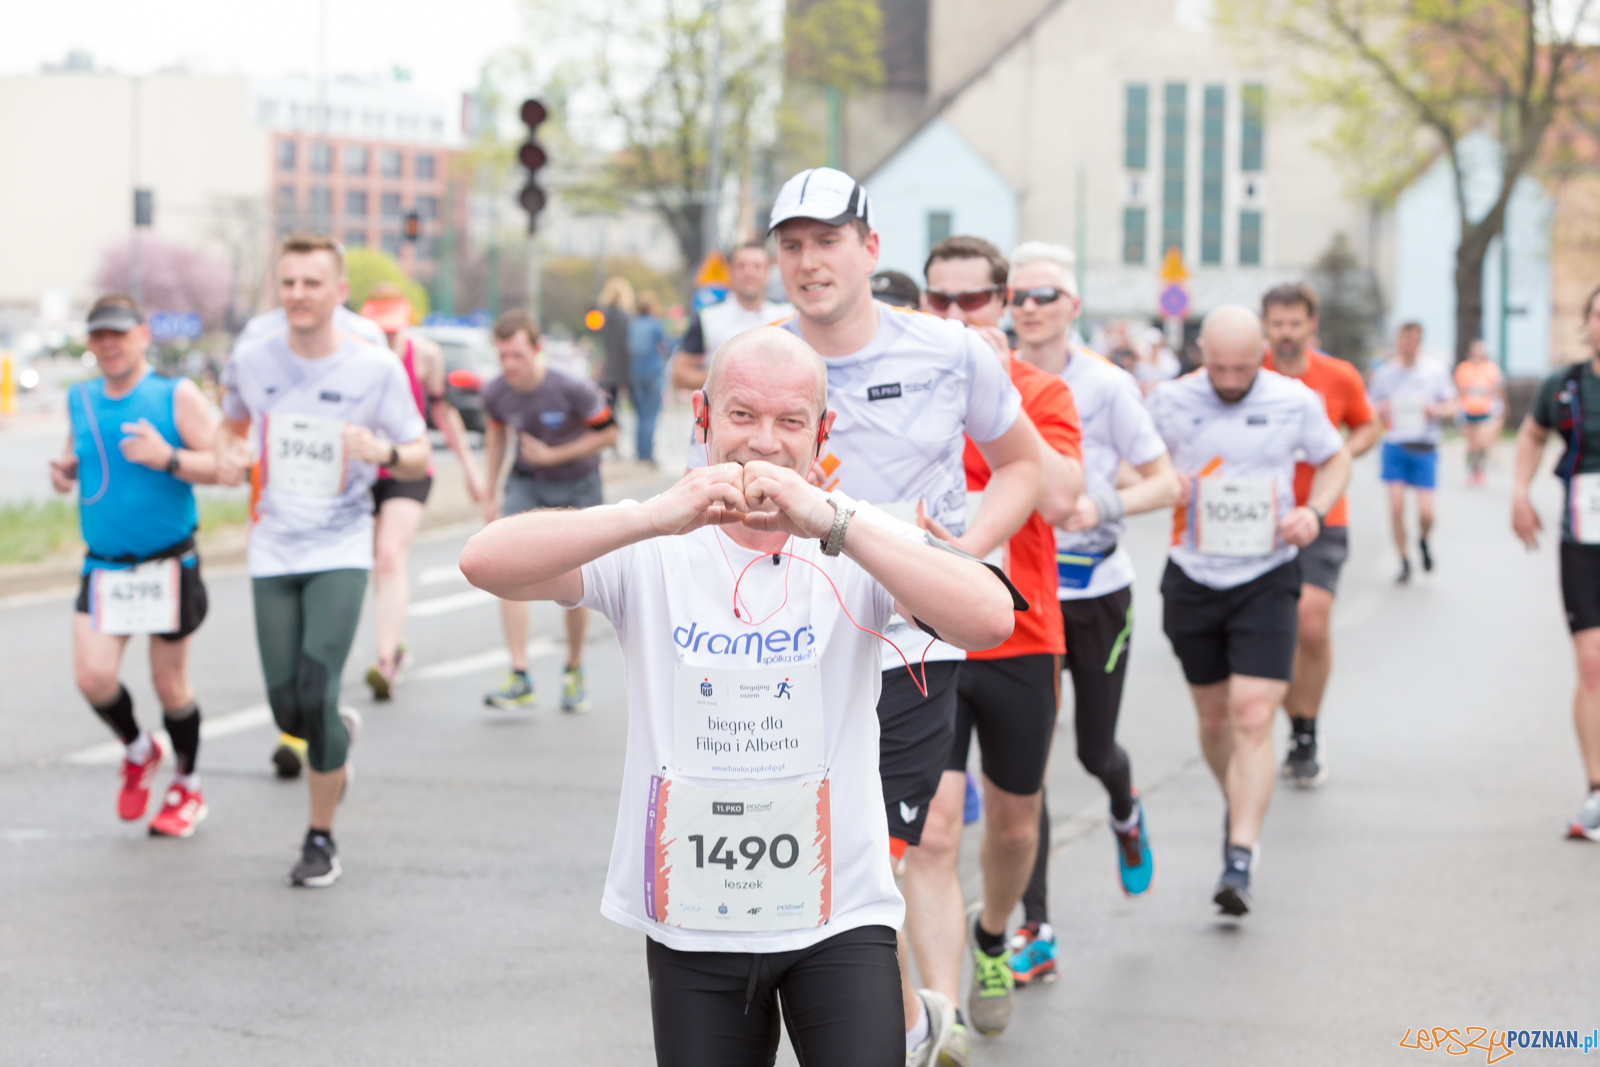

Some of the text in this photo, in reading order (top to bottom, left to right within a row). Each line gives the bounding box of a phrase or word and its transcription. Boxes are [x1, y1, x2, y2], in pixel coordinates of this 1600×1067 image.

[279, 439, 334, 463] 3948
[1206, 501, 1270, 522] 10547
[708, 716, 783, 735] biegnę dla
[696, 736, 799, 755] Filipa i Alberta
[725, 804, 742, 812] PKO
[687, 833, 800, 870] 1490
[724, 879, 764, 890] leszek
